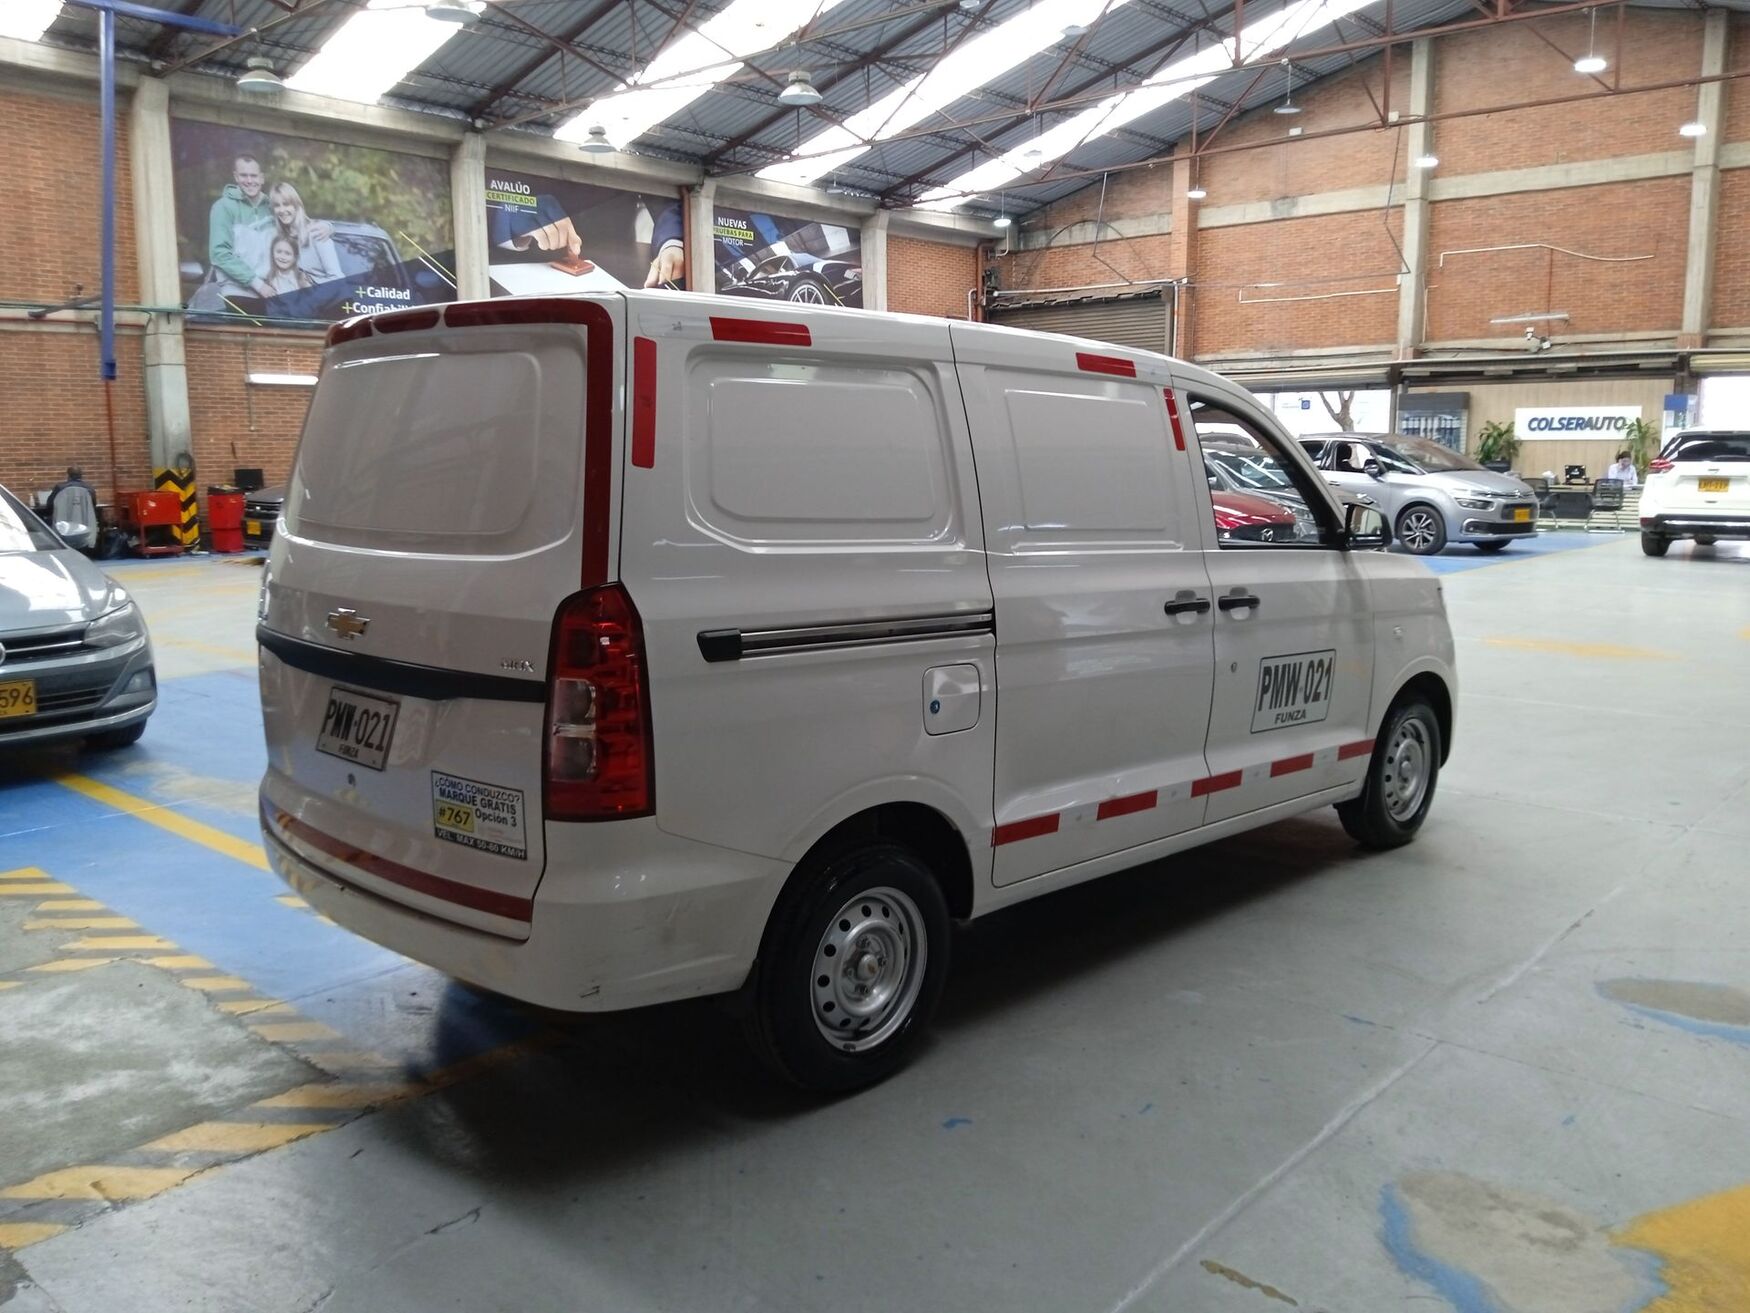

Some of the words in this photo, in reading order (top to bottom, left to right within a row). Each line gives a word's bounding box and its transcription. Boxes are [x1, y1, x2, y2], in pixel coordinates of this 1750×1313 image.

[490, 179, 531, 194] AVALÚO
[486, 191, 535, 205] CERTIFICADO
[717, 216, 747, 229] NUEVAS
[722, 236, 744, 247] MOTOR
[738, 230, 753, 239] PARA
[1527, 416, 1627, 432] COLSERAUTO
[1274, 709, 1307, 725] FUNZA
[465, 783, 520, 804] CONDUZCO?
[439, 787, 478, 807] MARQUE
[480, 797, 517, 816] GRATIS
[438, 806, 471, 826] #767
[511, 816, 518, 828] 3
